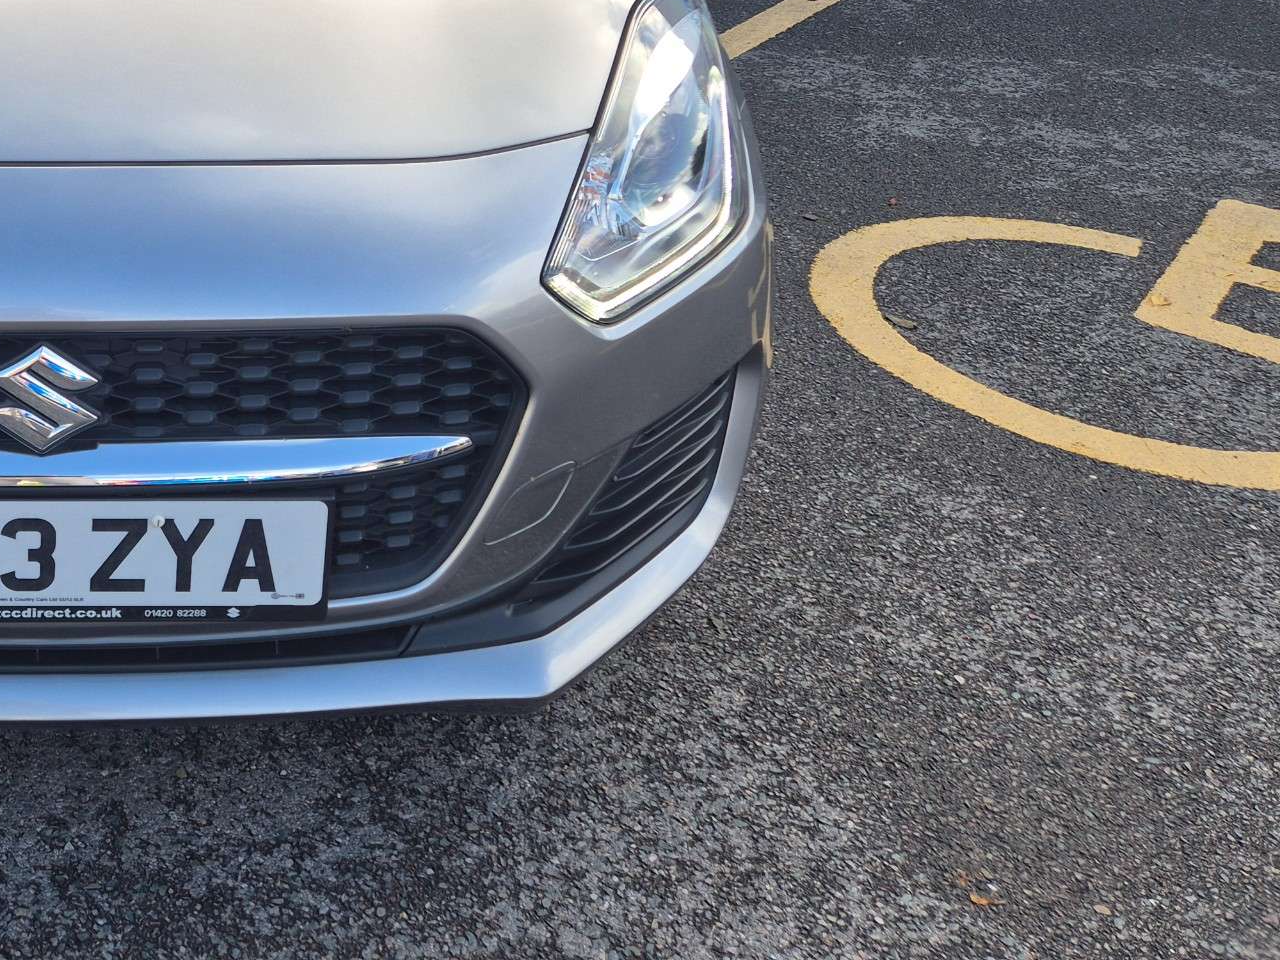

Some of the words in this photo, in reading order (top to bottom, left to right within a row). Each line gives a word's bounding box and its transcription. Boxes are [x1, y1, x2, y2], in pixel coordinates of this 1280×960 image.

[89, 518, 277, 592] ZYA
[144, 608, 173, 617] 01420
[177, 608, 206, 617] 82288
